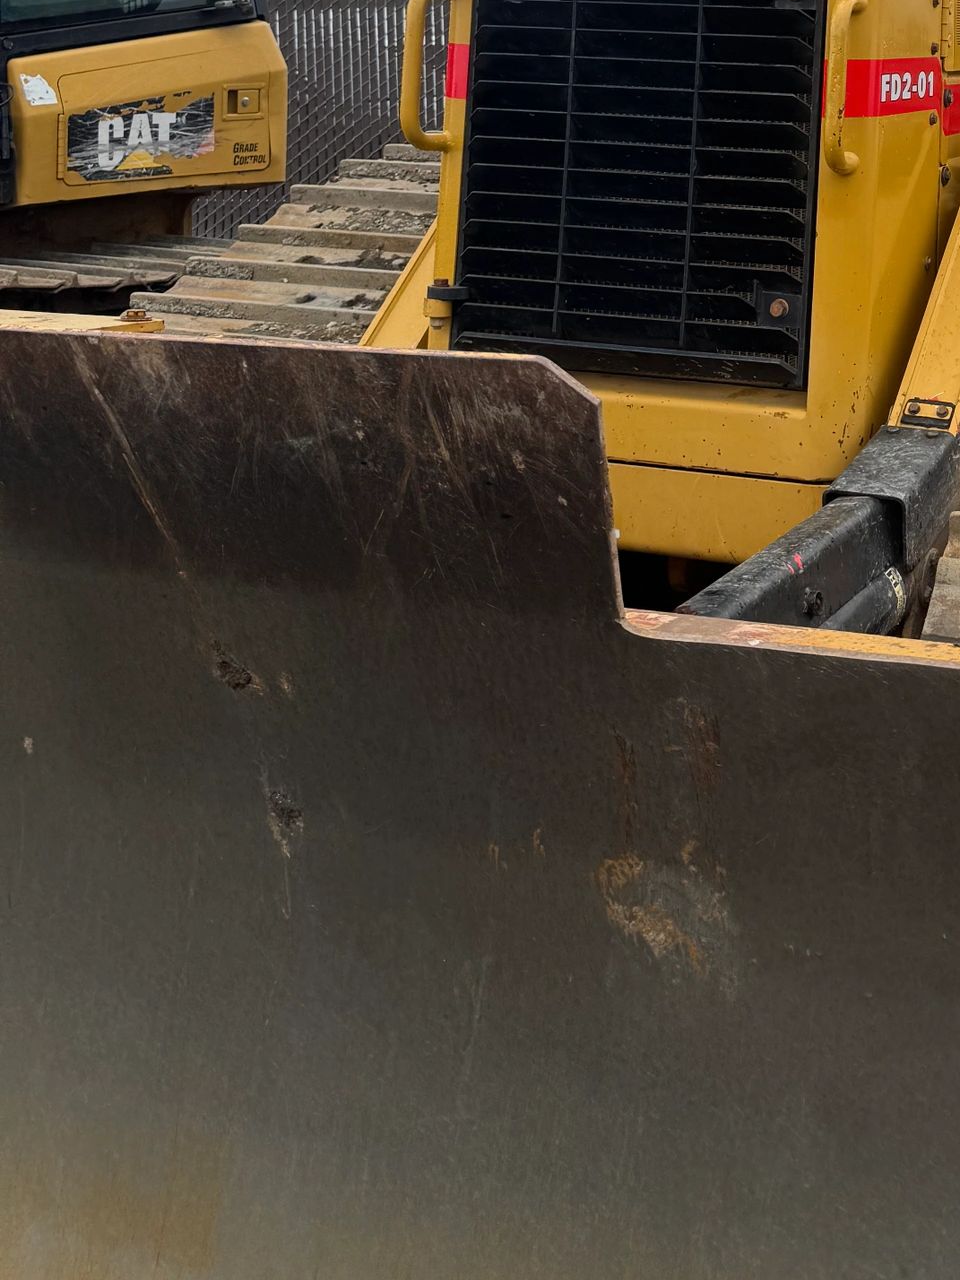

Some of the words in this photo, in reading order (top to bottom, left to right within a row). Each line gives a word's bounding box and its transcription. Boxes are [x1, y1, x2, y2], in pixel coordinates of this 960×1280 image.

[881, 70, 934, 103] FD2-01
[98, 112, 177, 171] CAT
[233, 142, 259, 154] GRADE
[233, 154, 266, 166] CONTROL
